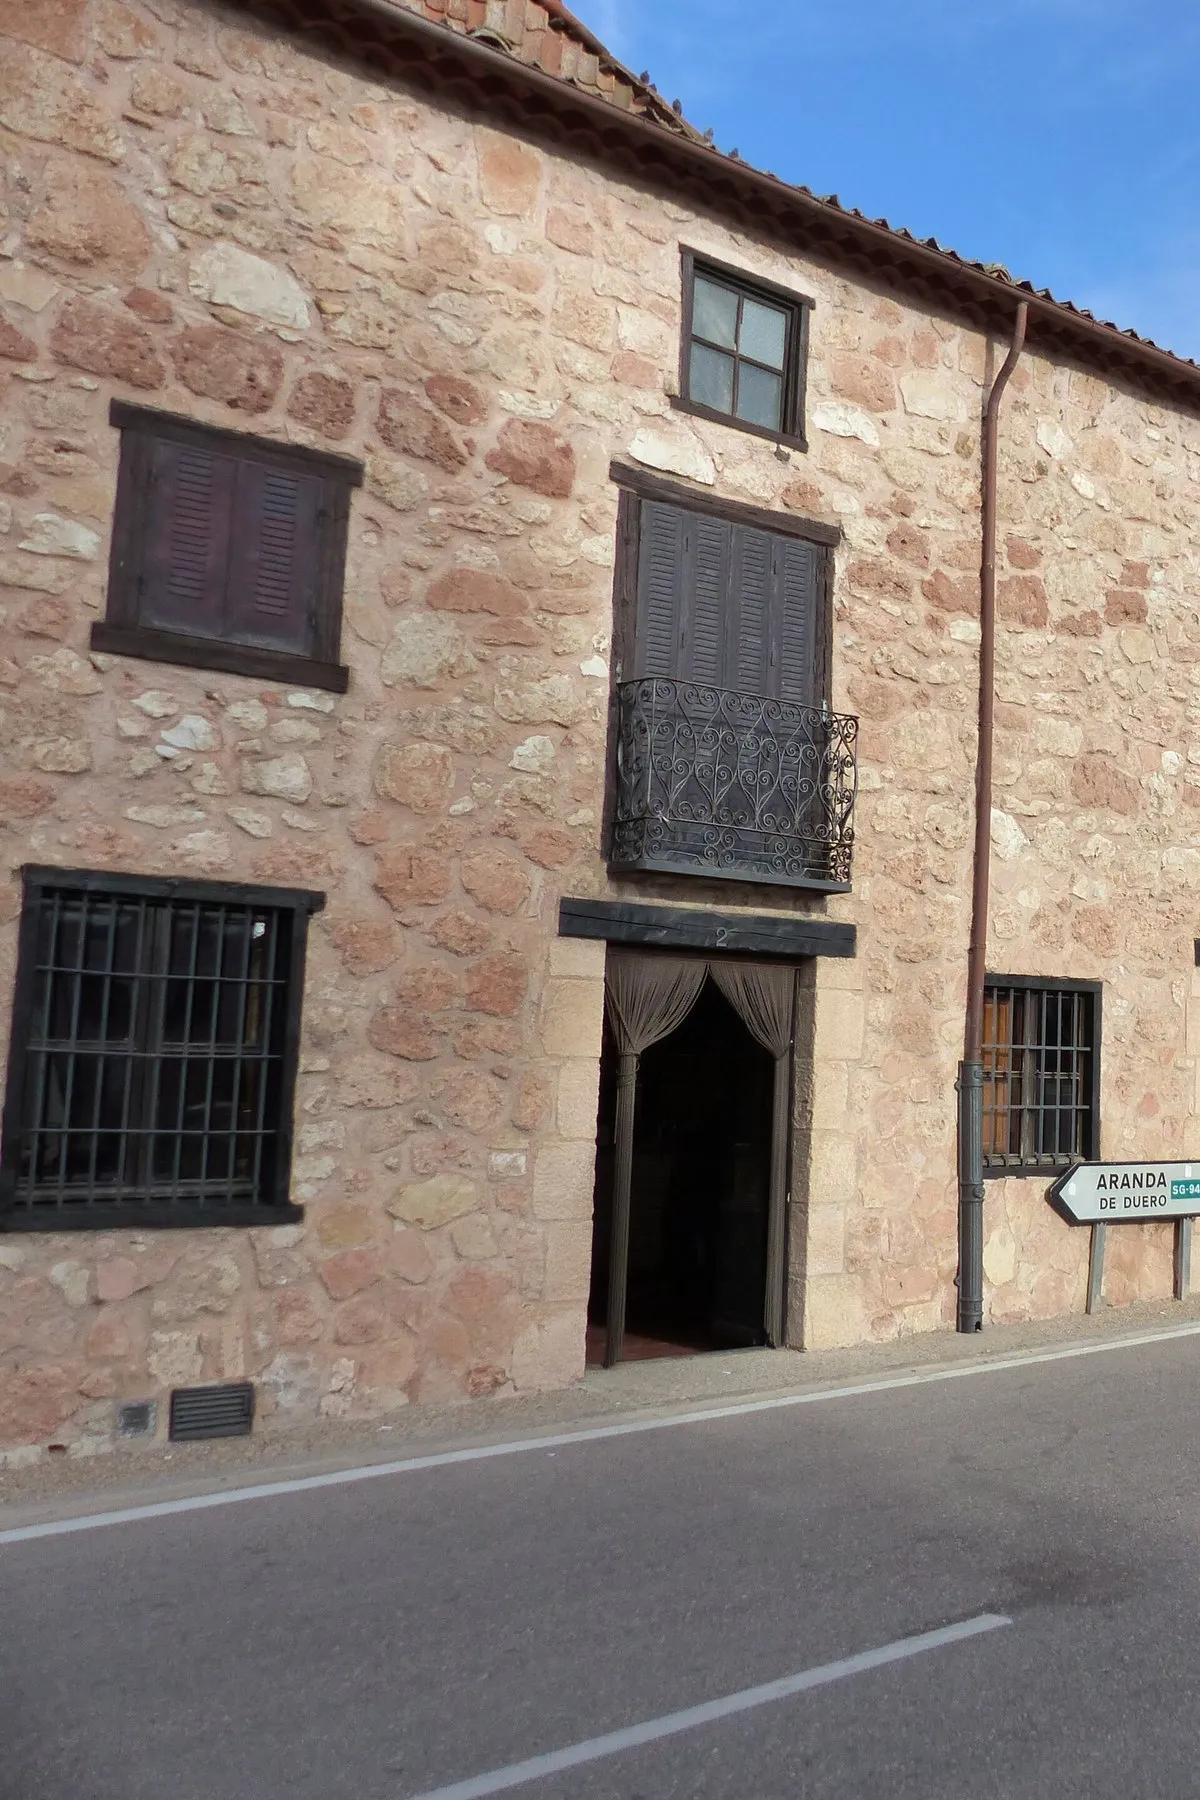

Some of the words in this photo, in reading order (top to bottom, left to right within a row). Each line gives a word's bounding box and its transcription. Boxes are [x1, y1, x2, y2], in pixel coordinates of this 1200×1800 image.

[716, 927, 728, 946] 2
[1096, 1172, 1167, 1190] ARANDA
[1099, 1197, 1116, 1210] DE
[1123, 1194, 1167, 1208] DUERO
